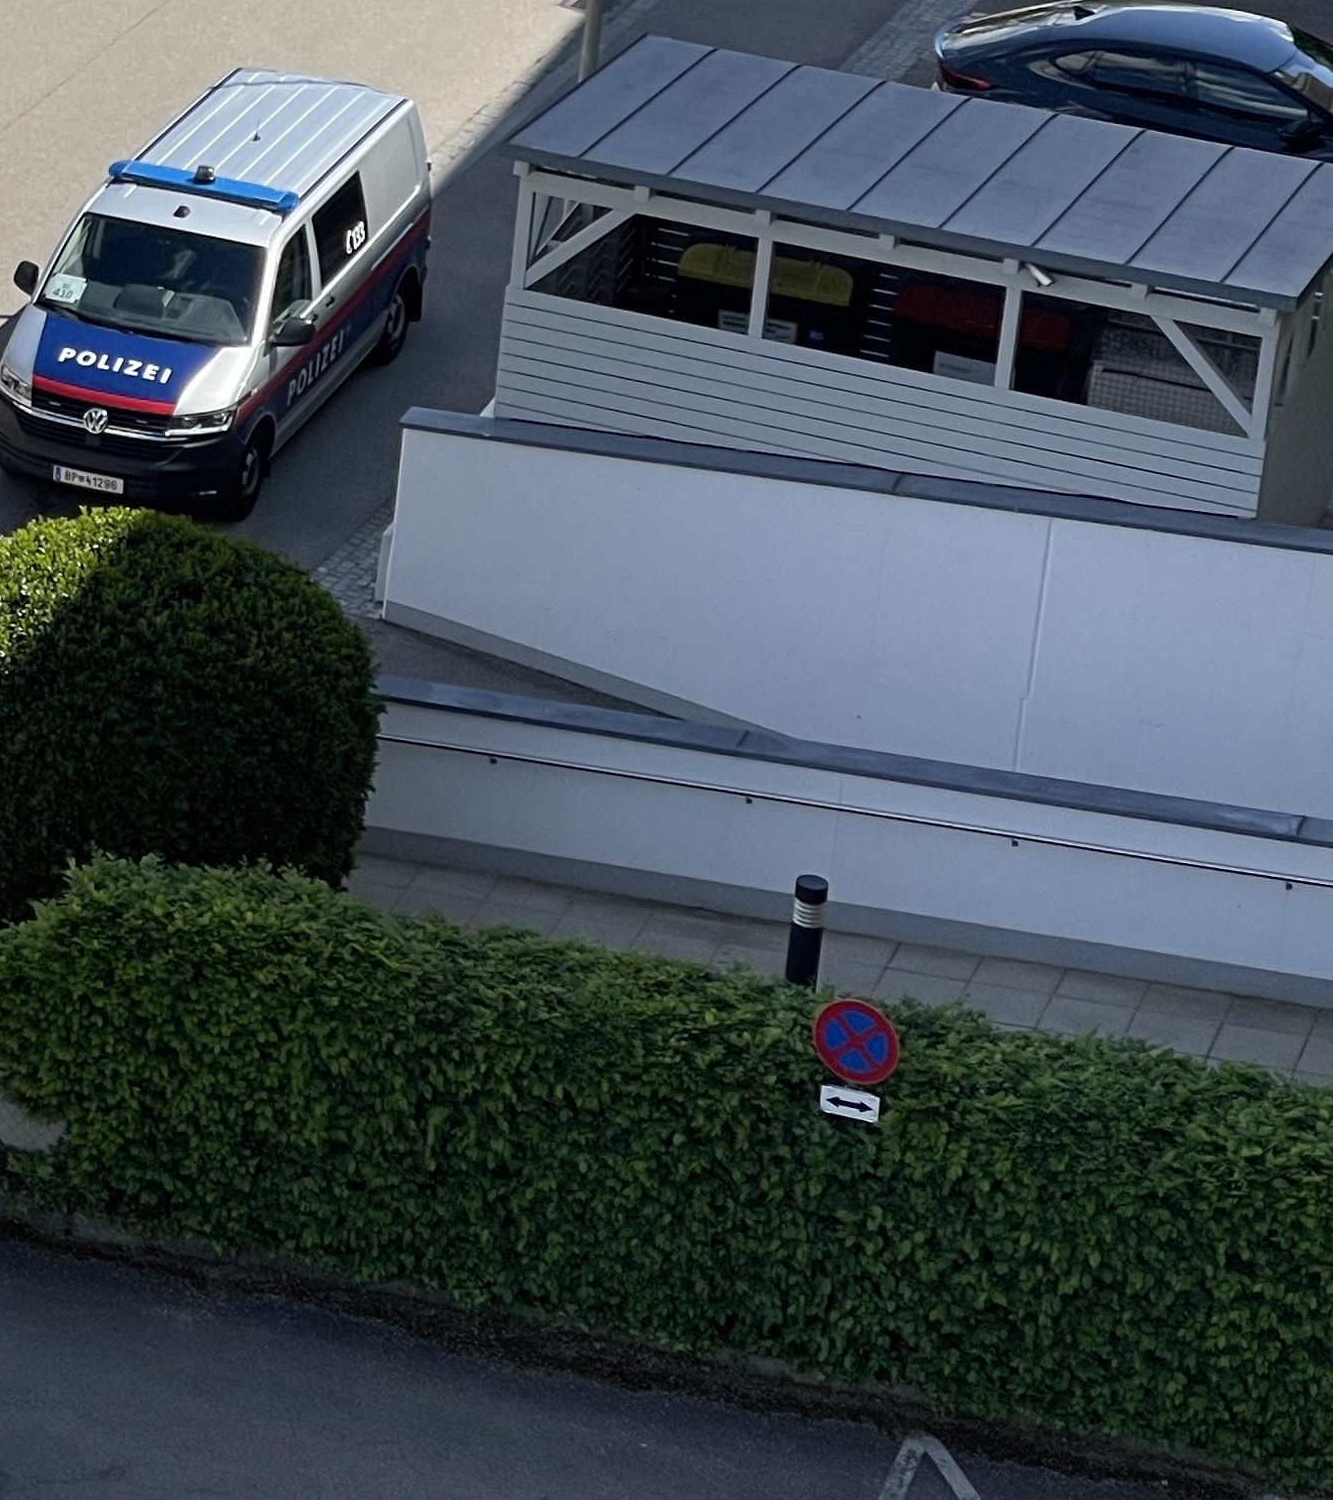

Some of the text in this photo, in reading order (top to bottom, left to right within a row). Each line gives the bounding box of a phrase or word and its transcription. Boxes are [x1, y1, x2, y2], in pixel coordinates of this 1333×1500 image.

[352, 221, 365, 250] 133
[53, 288, 74, 299] 410
[57, 347, 172, 384] POLIZEI
[286, 328, 344, 406] POLIZEI
